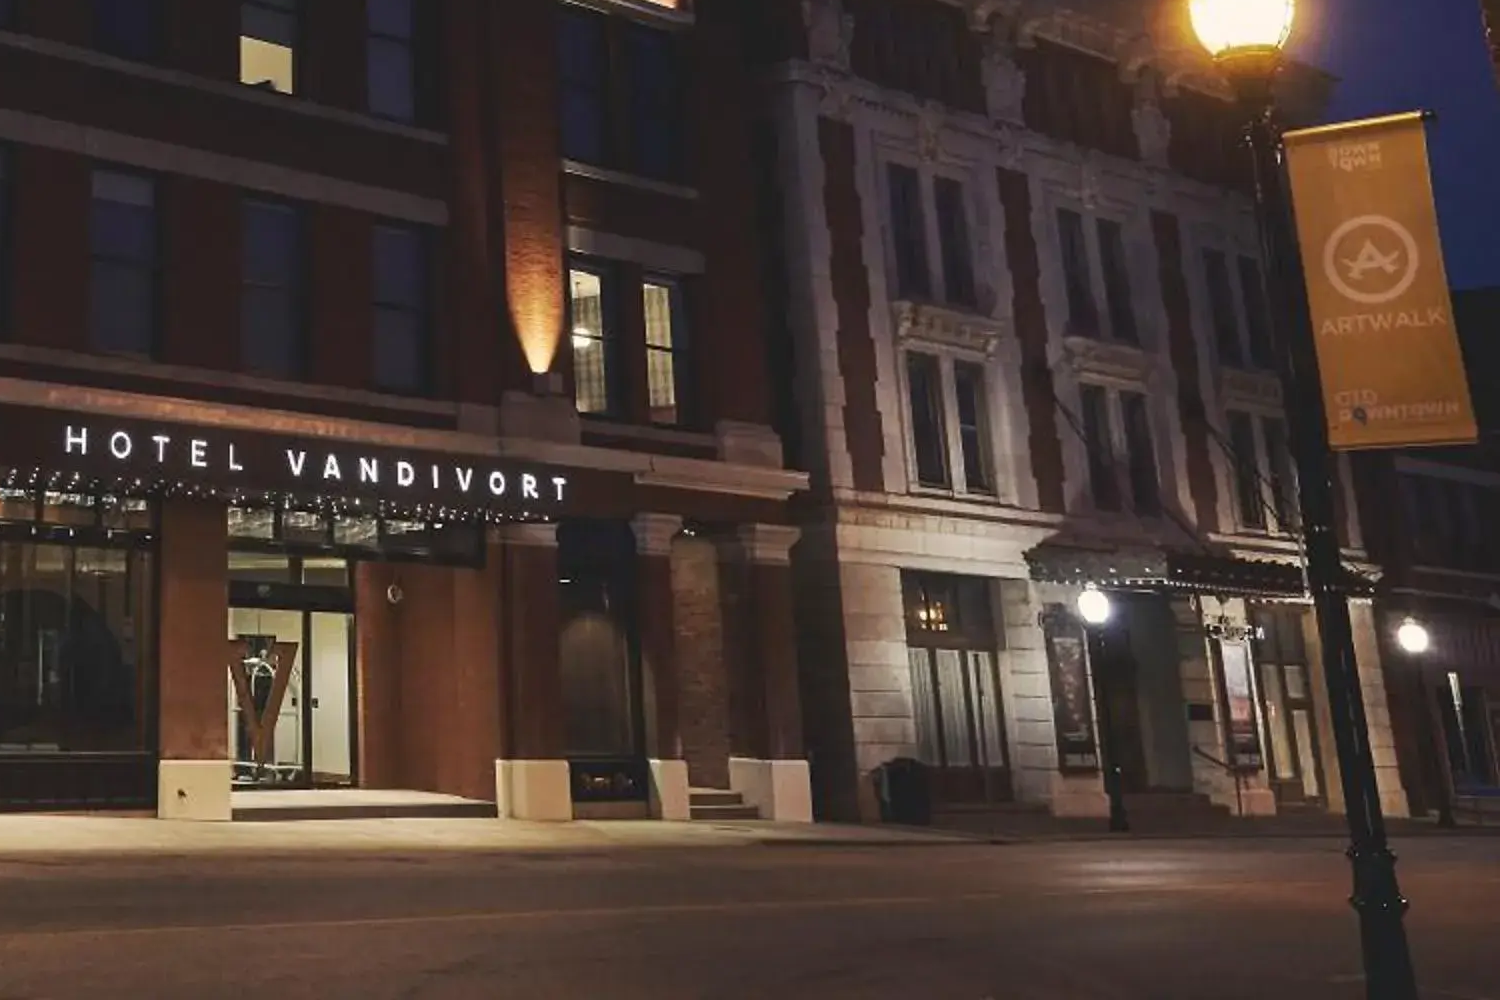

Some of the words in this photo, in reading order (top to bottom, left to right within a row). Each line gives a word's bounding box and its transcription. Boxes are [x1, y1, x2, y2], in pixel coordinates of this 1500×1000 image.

[1320, 307, 1446, 337] ARTWALK
[64, 424, 244, 472] HOTEL
[286, 448, 569, 503] VANDIVORT
